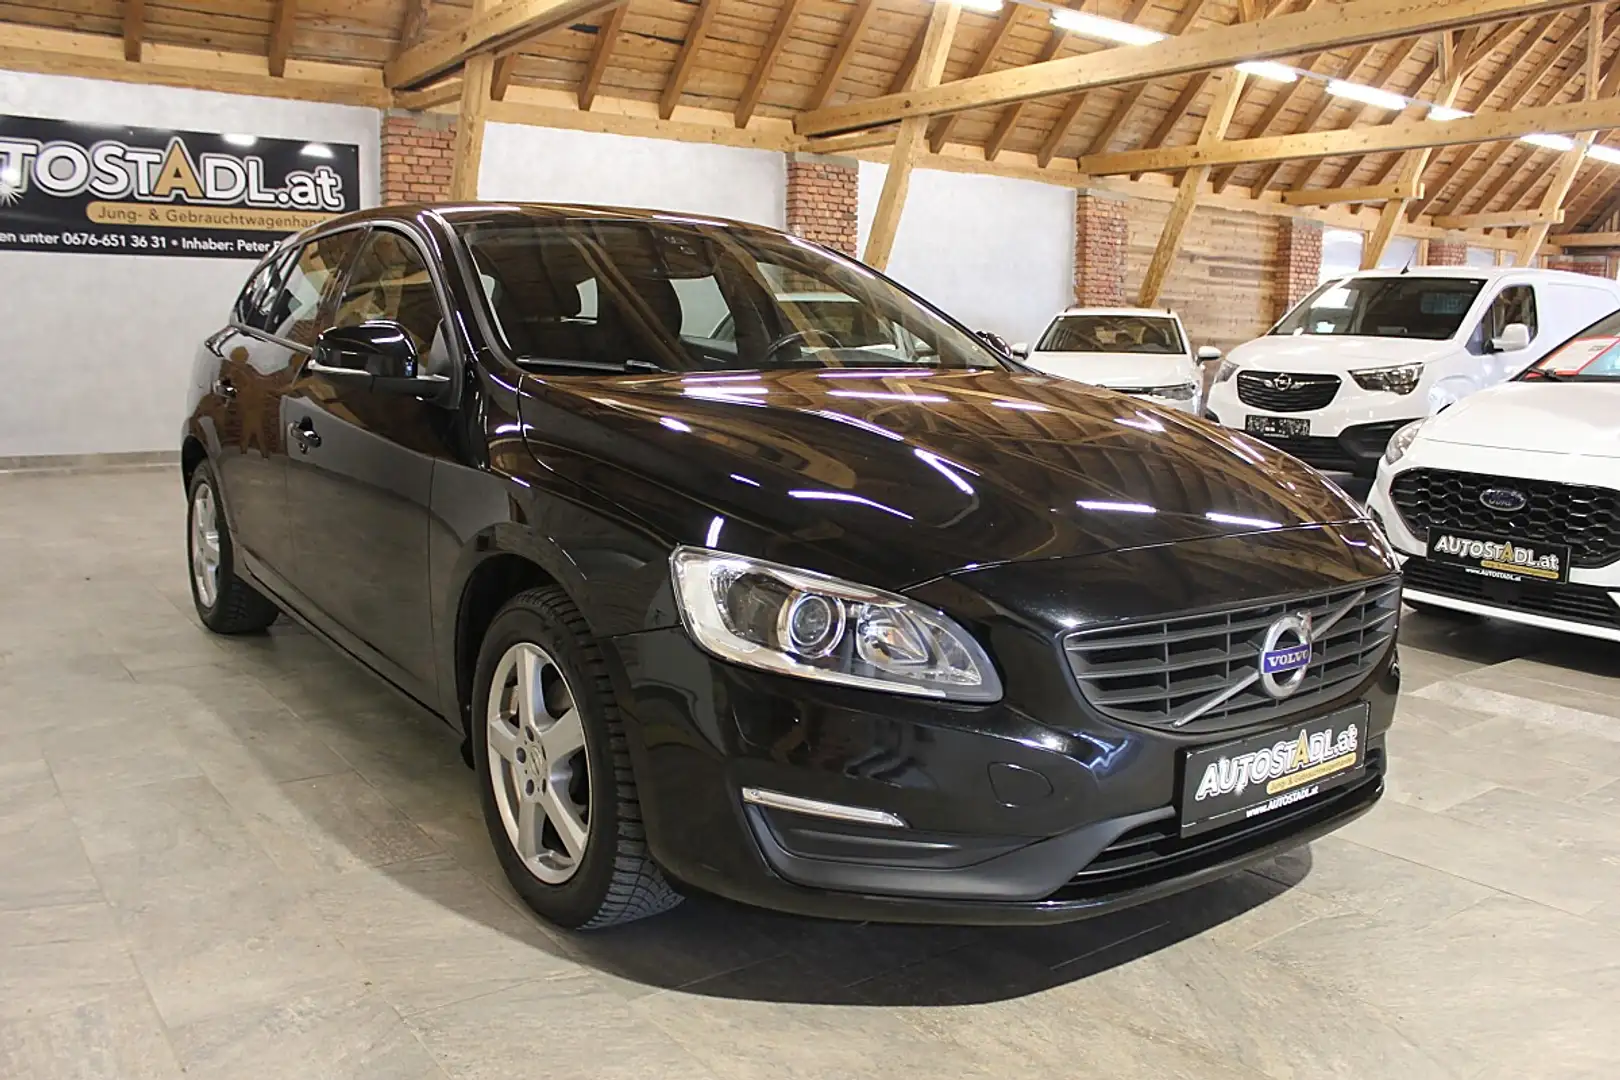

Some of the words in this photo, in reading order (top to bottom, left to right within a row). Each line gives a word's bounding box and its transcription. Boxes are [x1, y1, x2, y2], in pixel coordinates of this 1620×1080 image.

[98, 206, 142, 223] Jung-
[149, 208, 160, 222] &
[20, 232, 59, 244] unter
[62, 232, 126, 247] 0676-651
[130, 235, 148, 248] 36
[151, 236, 166, 249] 31
[182, 238, 234, 251] Inhaber:
[237, 240, 270, 252] Peter
[1434, 533, 1559, 571] AUTOSTADL.at
[1267, 650, 1308, 667] VOLVO
[1195, 724, 1358, 801] AUTOSTADL.at
